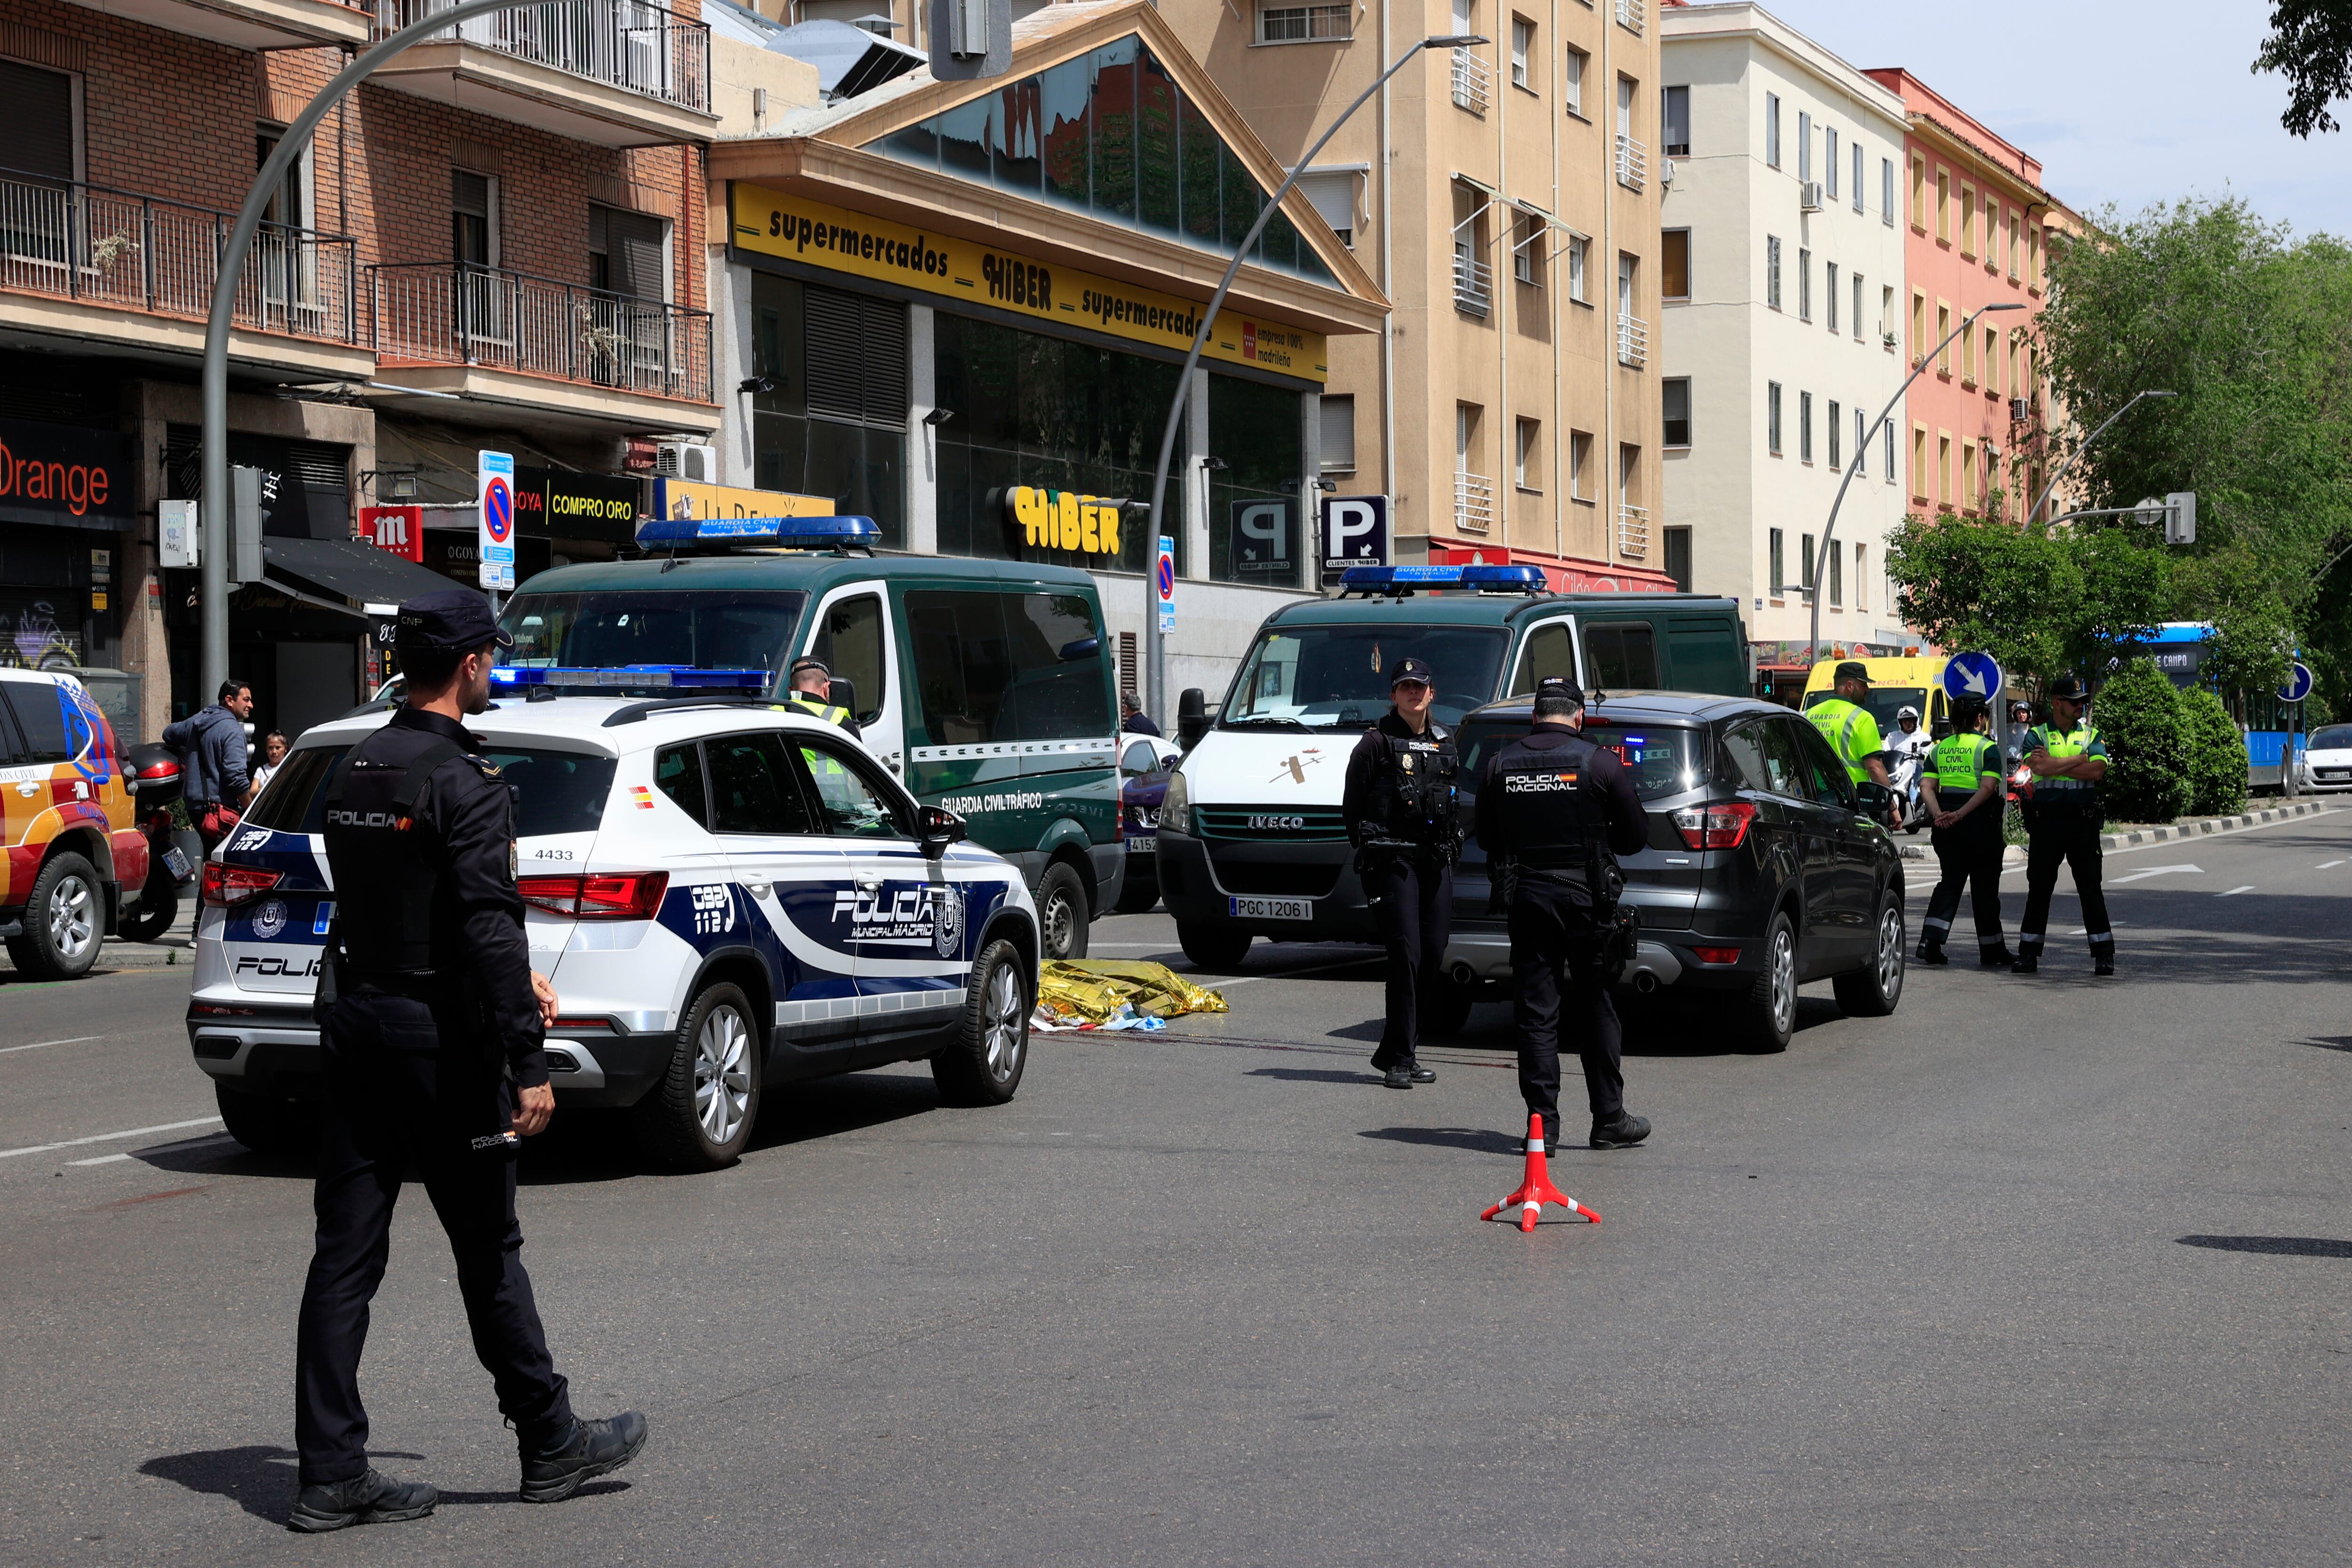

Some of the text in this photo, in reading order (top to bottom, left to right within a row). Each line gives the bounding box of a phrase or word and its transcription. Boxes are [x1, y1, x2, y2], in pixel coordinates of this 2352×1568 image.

[769, 210, 948, 277] supermercados
[1257, 328, 1303, 350] empresa 100%
[1257, 349, 1291, 367] madrileña
[553, 495, 632, 521] COMPRO ORO
[1330, 501, 1375, 557] P
[456, 546, 480, 560] GOYA
[401, 616, 422, 626] CNP
[1826, 680, 1907, 689] AANCIA
[15, 768, 38, 780] CIVIL
[1939, 764, 1971, 773] TRÁFICO
[1506, 774, 1562, 784] POLICIA
[1506, 782, 1577, 792] NACIONAL
[942, 790, 1042, 814] GUARDIA CIVIL TRÁFICO
[328, 810, 397, 828] POLICIA
[1247, 816, 1304, 830] IVECO
[535, 850, 573, 861] 4433
[832, 884, 934, 922] POLICÍA
[1370, 896, 1381, 905] CNP
[1238, 900, 1264, 915] PGC
[1268, 902, 1301, 917] 1206
[694, 911, 721, 934] 112
[851, 924, 934, 937] MUNICIPAL MADRID
[471, 1132, 509, 1145] POLICIA
[473, 1136, 517, 1150] NACIONAL
